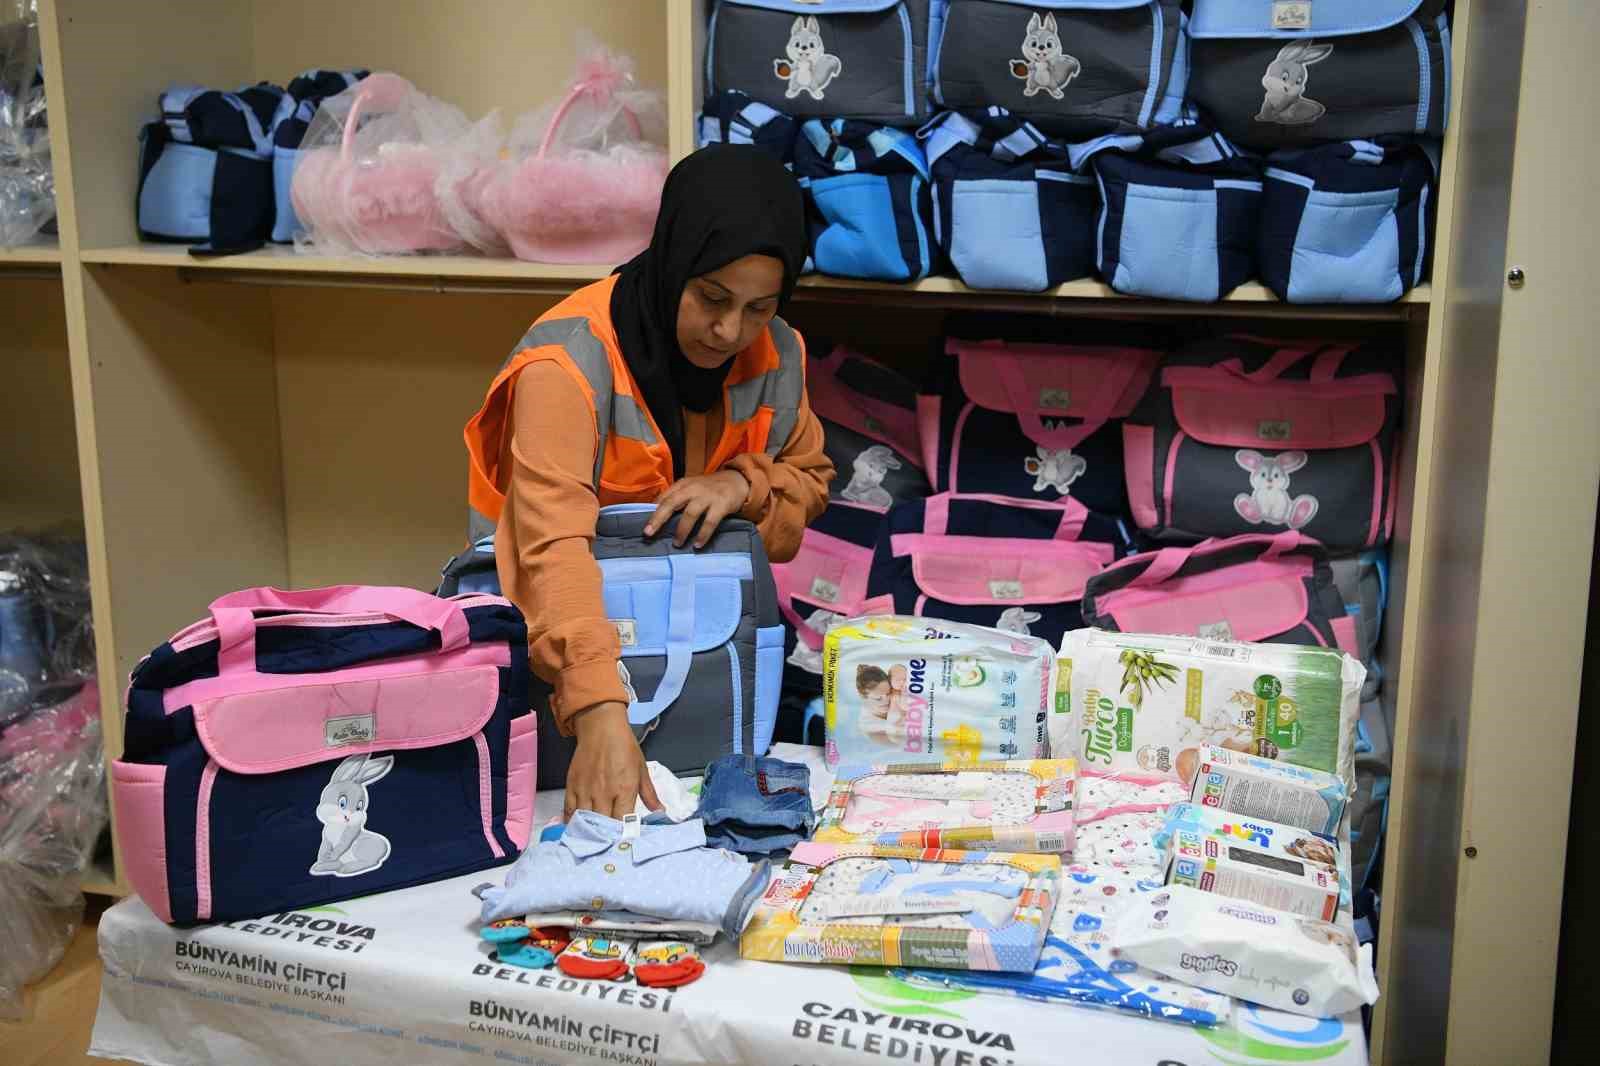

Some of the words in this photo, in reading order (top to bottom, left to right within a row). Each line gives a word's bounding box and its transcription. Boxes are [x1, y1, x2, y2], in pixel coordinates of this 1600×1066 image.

[1081, 698, 1114, 764] Turco
[1280, 703, 1292, 720] 40
[175, 940, 277, 976] BÜNYAMİN
[283, 963, 347, 992] ÇİFTÇİ
[472, 963, 678, 1013] BELEDİYESİ
[1180, 953, 1239, 977] giggles
[469, 1000, 583, 1038] BÜNYAMİN
[589, 1024, 660, 1054] ÇİFTÇİ
